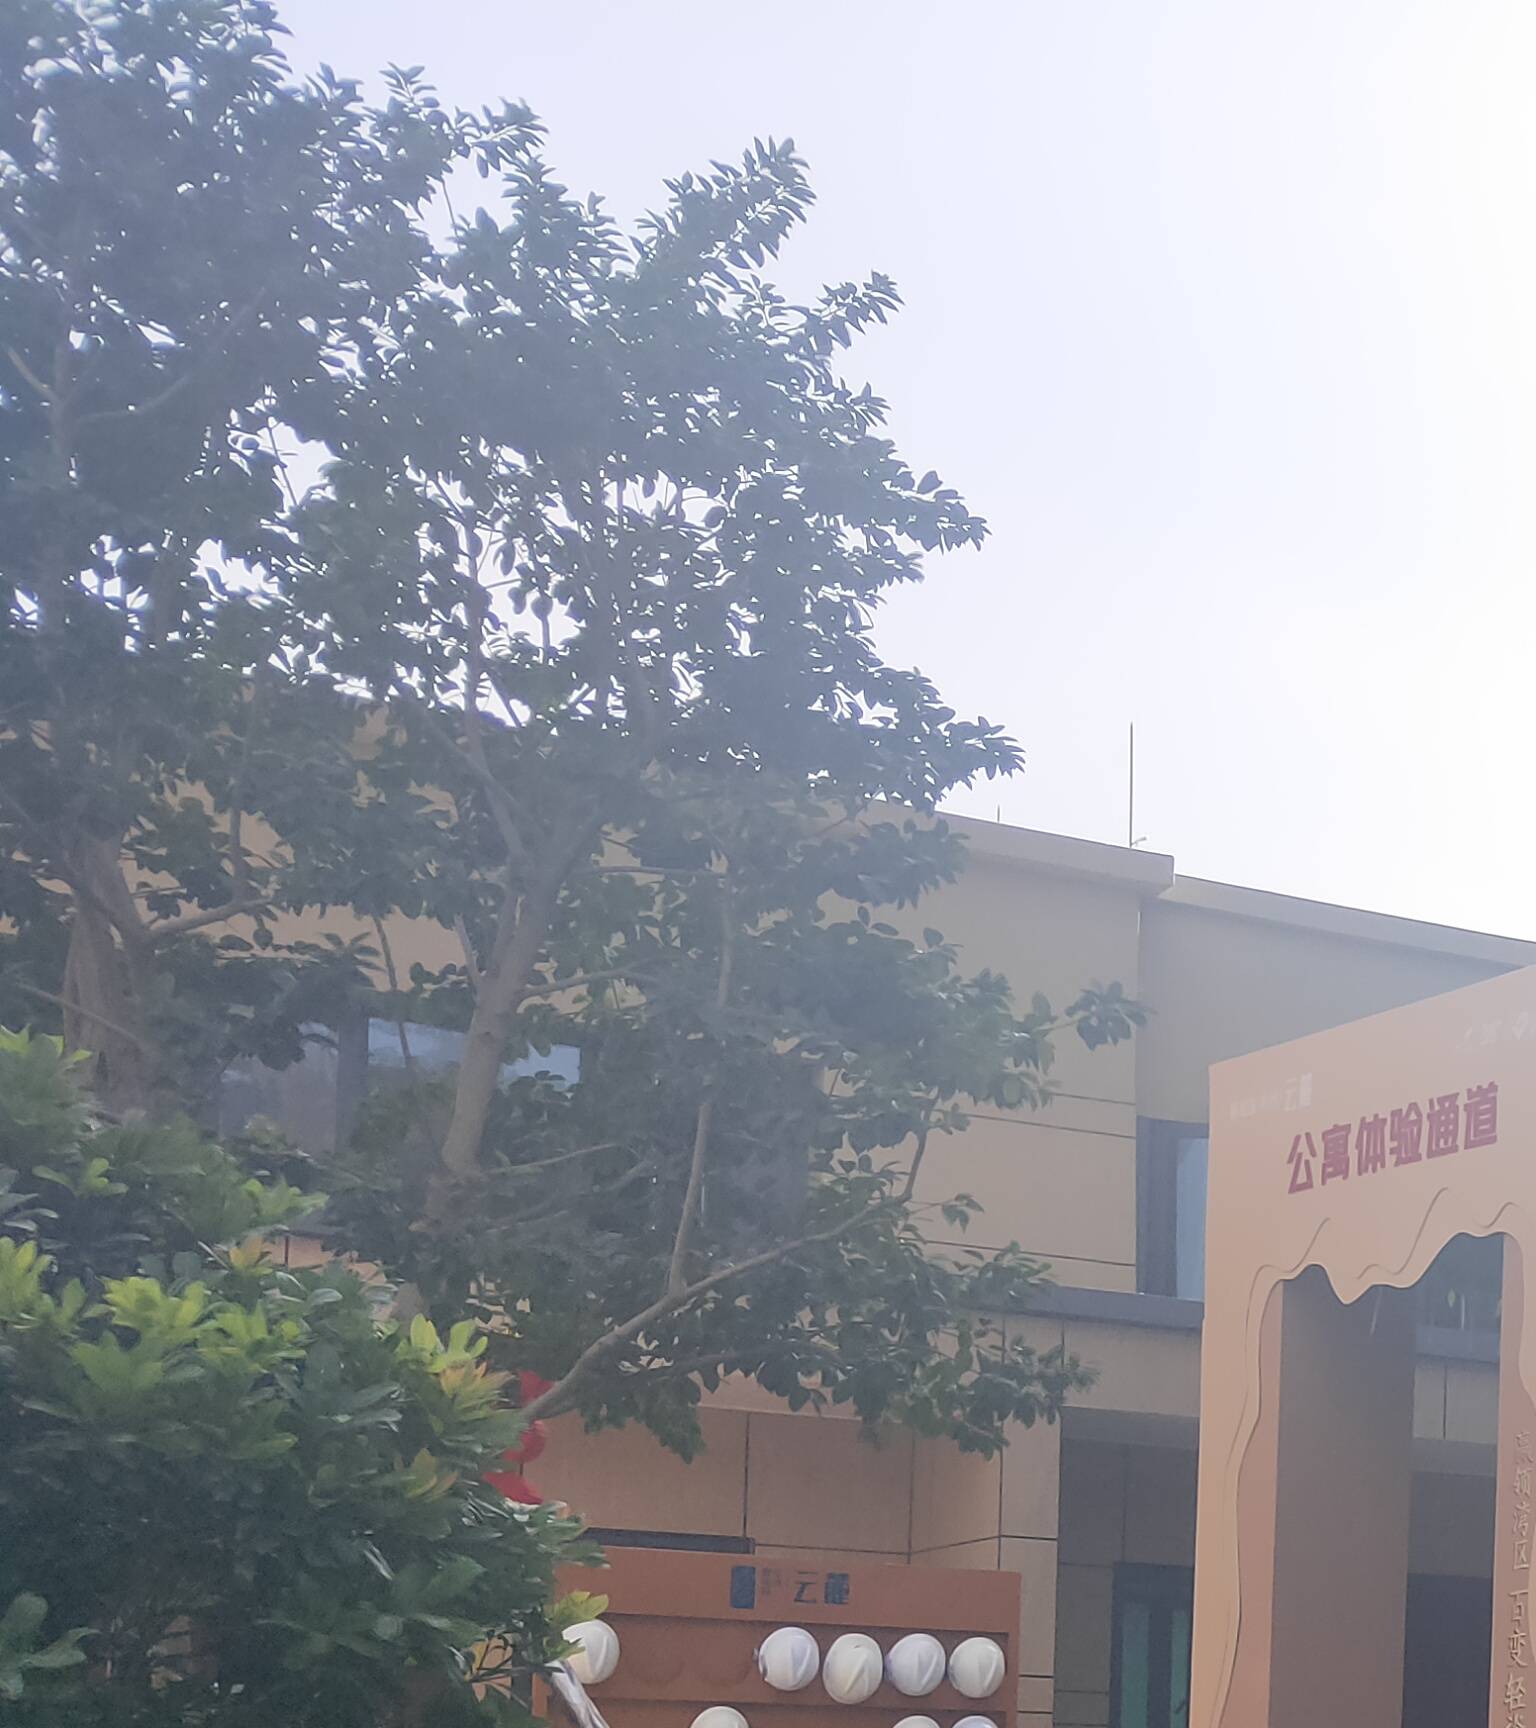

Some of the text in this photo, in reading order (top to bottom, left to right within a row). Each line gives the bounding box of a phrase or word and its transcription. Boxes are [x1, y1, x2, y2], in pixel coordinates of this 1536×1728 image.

[1286, 1081, 1499, 1195] 公寓体验通道
